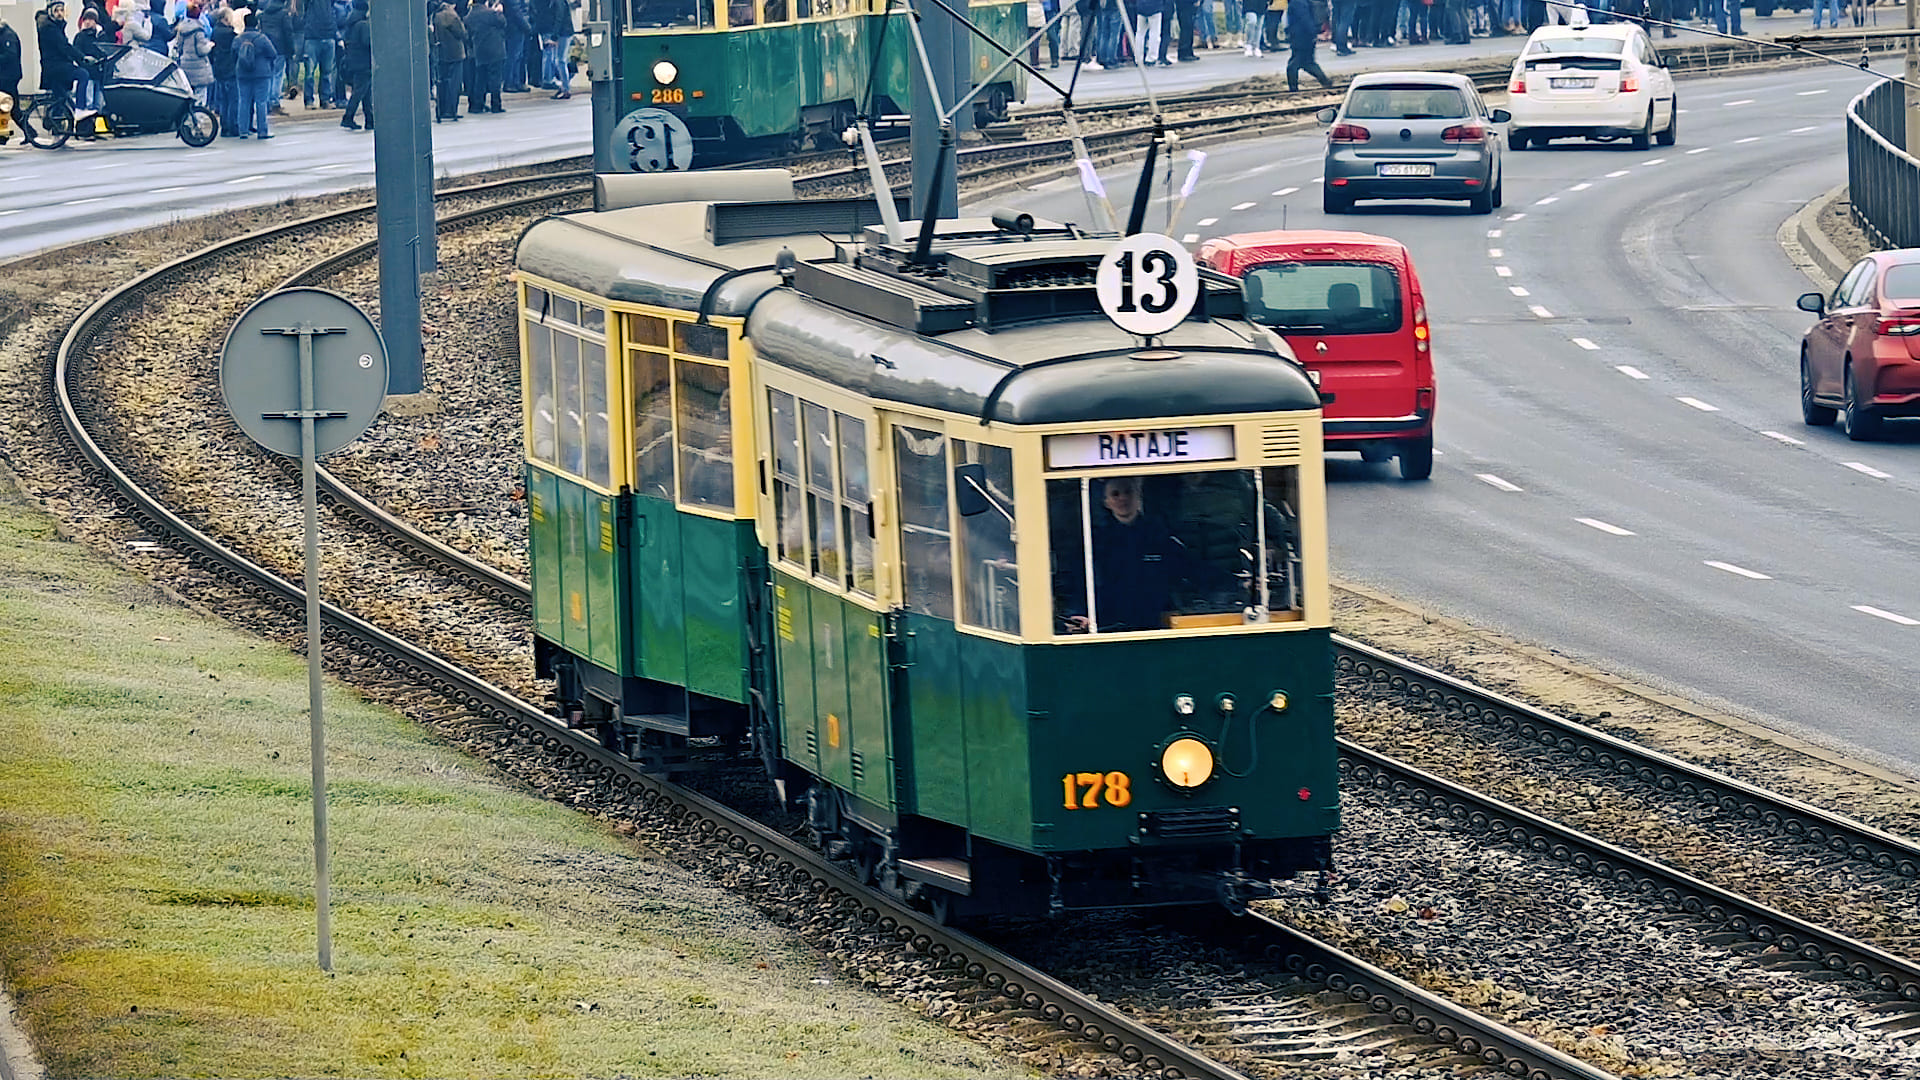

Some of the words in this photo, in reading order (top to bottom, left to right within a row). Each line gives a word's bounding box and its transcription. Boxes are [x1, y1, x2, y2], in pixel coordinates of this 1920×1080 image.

[651, 88, 684, 104] 286
[1114, 249, 1178, 314] 13
[1098, 430, 1189, 460] RATAJE
[1061, 770, 1133, 810] 178
